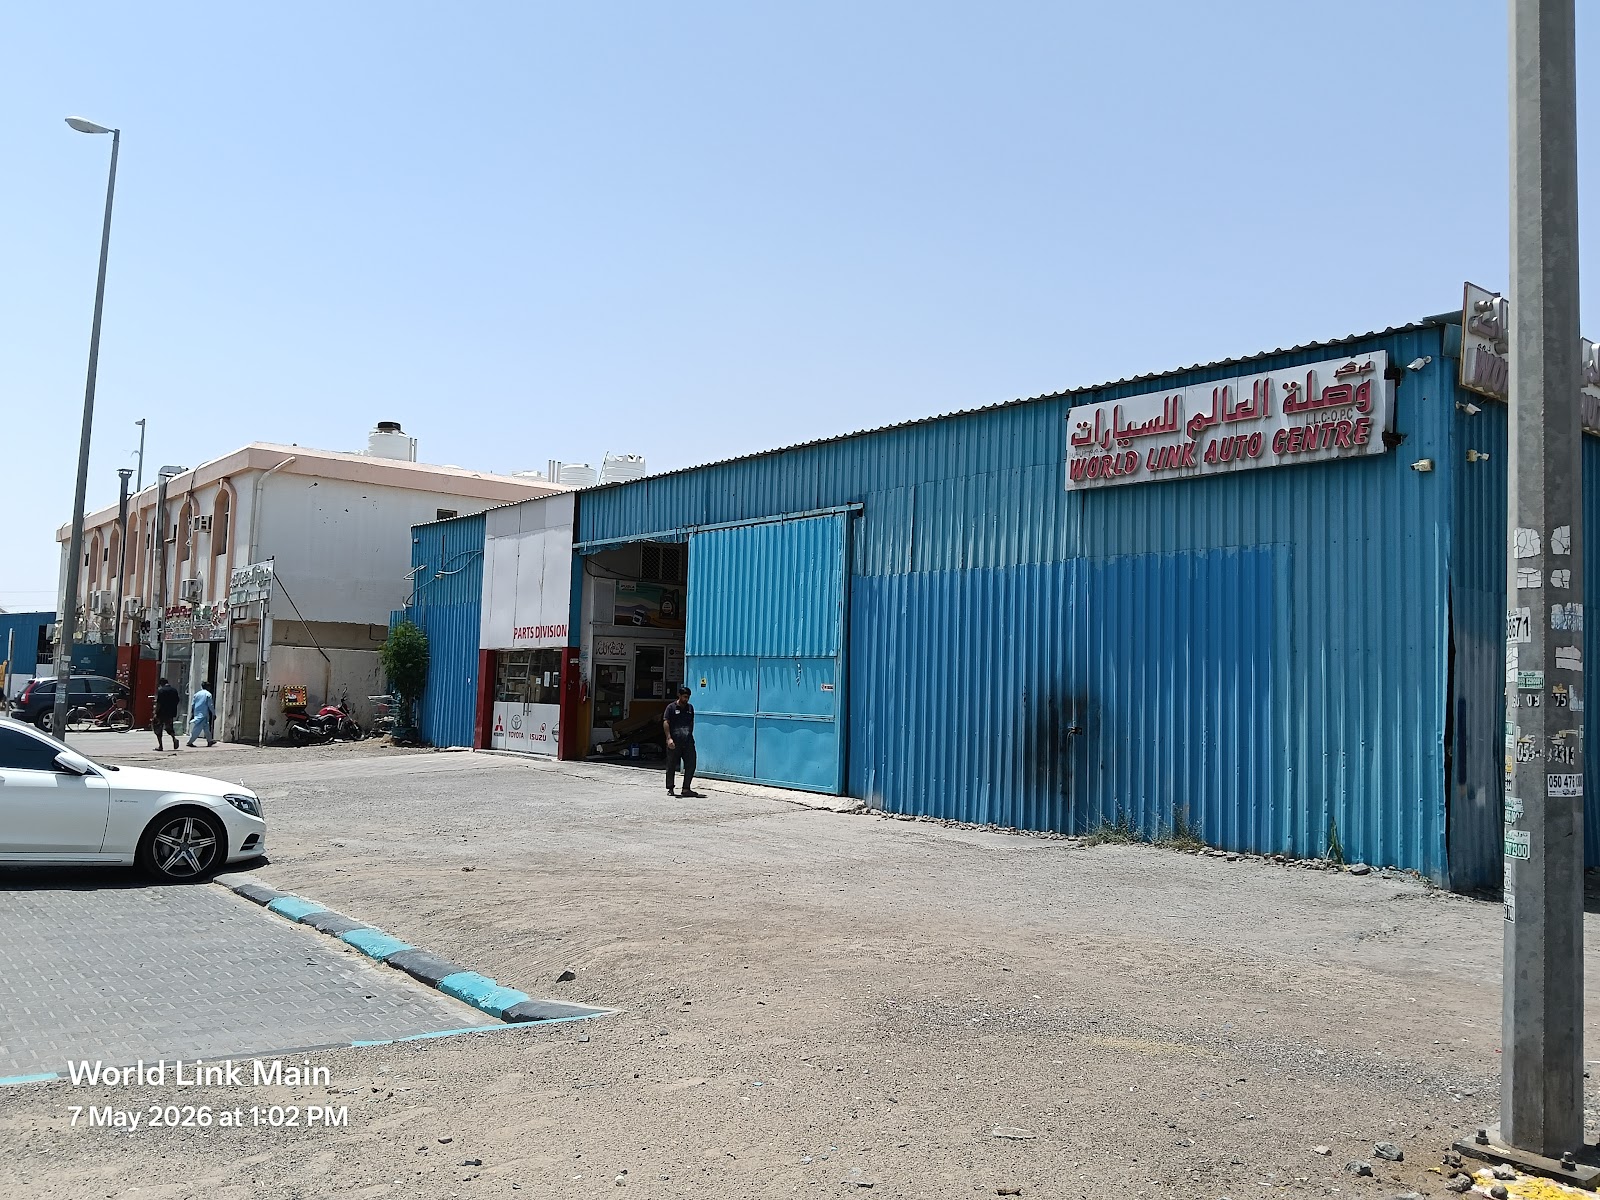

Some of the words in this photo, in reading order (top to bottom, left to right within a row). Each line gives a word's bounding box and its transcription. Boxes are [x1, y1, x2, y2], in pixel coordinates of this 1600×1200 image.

[1282, 369, 1373, 414] وصلة
[1070, 395, 1181, 450] للسيارات
[1186, 378, 1272, 442] العالم
[1069, 450, 1140, 481] WORLD
[1145, 441, 1198, 472] LINK
[1203, 431, 1265, 465] AUTO
[1271, 415, 1372, 456] CENTRE
[513, 626, 534, 640] PARTS
[535, 624, 568, 639] DIVISION
[508, 730, 525, 740] TOYOTA
[529, 733, 547, 742] ISUZU
[1548, 775, 1562, 788] 050
